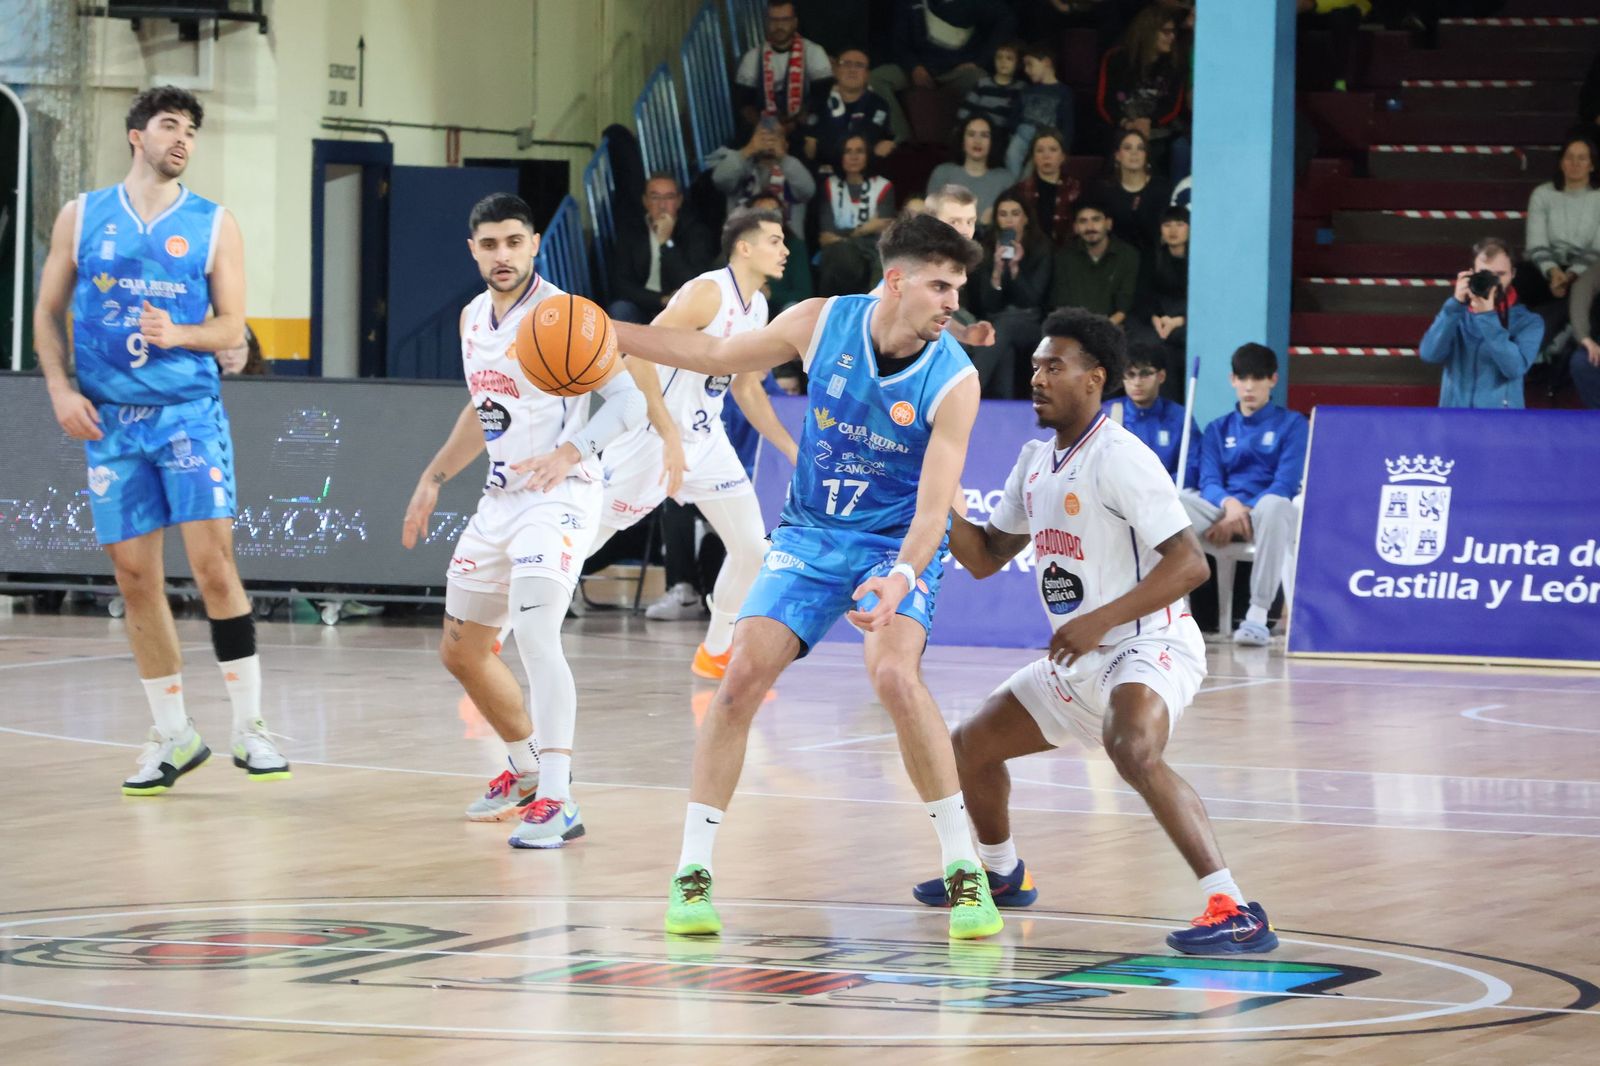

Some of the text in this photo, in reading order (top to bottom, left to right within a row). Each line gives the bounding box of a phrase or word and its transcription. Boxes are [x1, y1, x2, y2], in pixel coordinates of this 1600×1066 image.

[126, 332, 149, 369] 9
[822, 479, 870, 517] 17
[1452, 536, 1560, 566] Junta
[1349, 569, 1479, 600] Castilla
[1485, 579, 1513, 609] y
